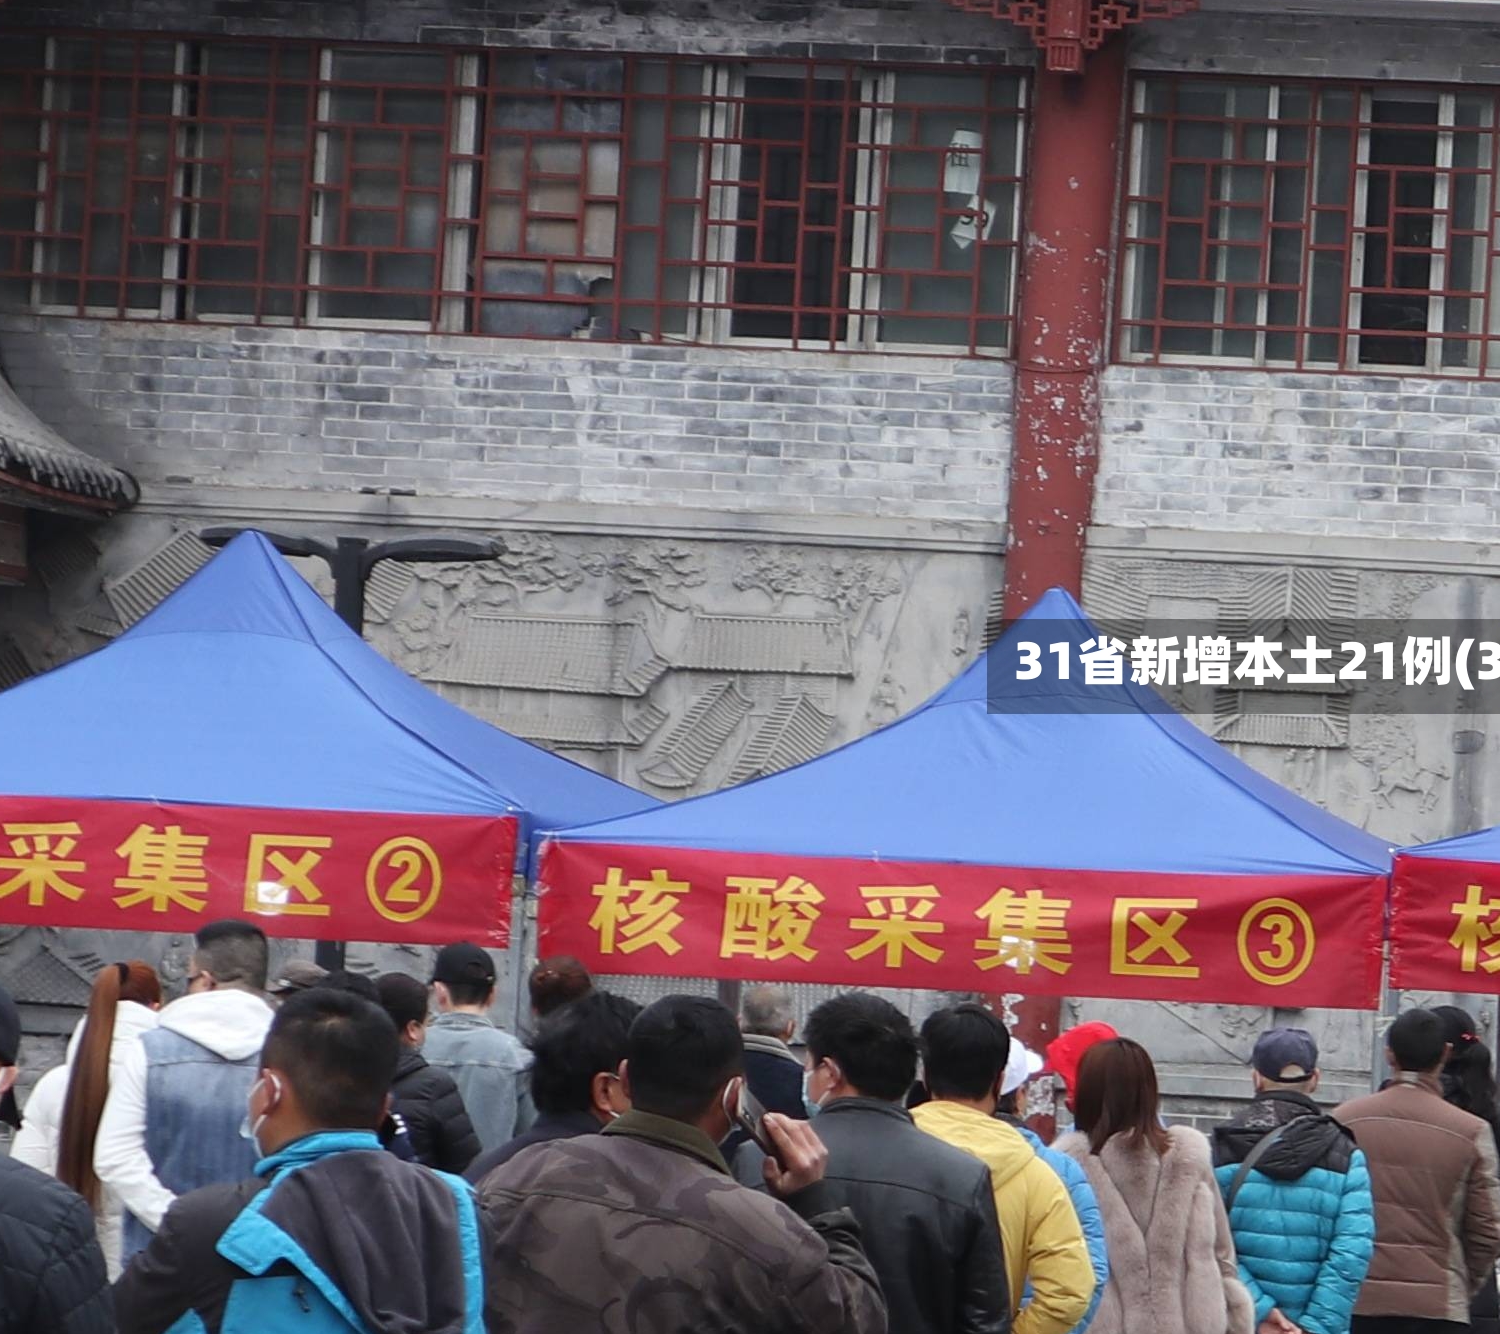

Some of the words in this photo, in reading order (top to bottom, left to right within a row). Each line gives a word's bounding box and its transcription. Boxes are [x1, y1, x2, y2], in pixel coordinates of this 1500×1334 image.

[588, 867, 1316, 987] 核酸采集区③
